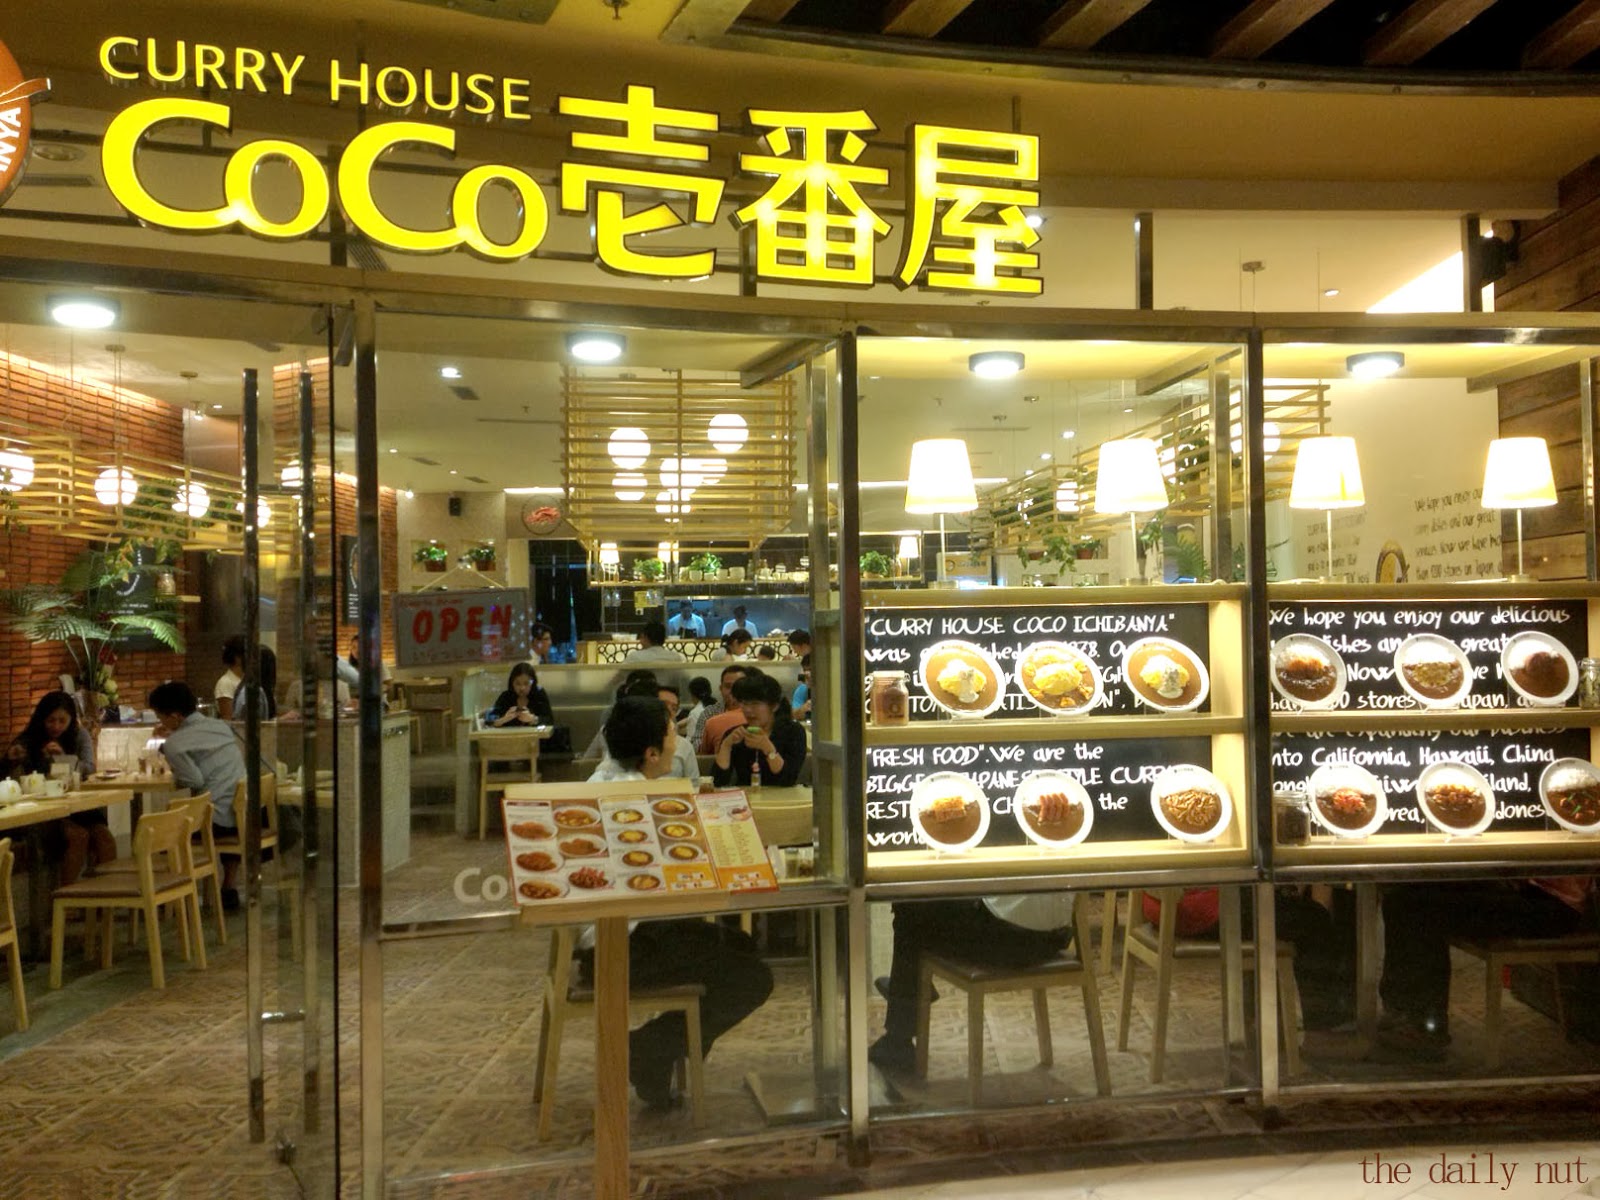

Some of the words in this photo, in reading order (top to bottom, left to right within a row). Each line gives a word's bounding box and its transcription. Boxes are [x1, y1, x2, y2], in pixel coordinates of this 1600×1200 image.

[100, 36, 305, 95] CURRY
[330, 59, 531, 119] HOUSE
[101, 97, 549, 258] CoCo
[558, 84, 1043, 295] 壱番屋
[412, 603, 513, 645] OPEN
[942, 617, 1006, 634] HOUSE
[1013, 616, 1067, 635] COCO
[1270, 608, 1295, 625] We
[1304, 607, 1345, 629] hope
[1354, 611, 1386, 629] you
[1394, 610, 1442, 629] enjoy
[1450, 611, 1484, 625] our
[1491, 606, 1570, 624] delicious
[864, 648, 911, 663] was
[1357, 690, 1416, 709] stores
[1460, 692, 1509, 709] apan,
[989, 744, 1026, 762] We
[1033, 747, 1065, 762] are
[1074, 742, 1104, 761] the
[1098, 792, 1128, 810] the
